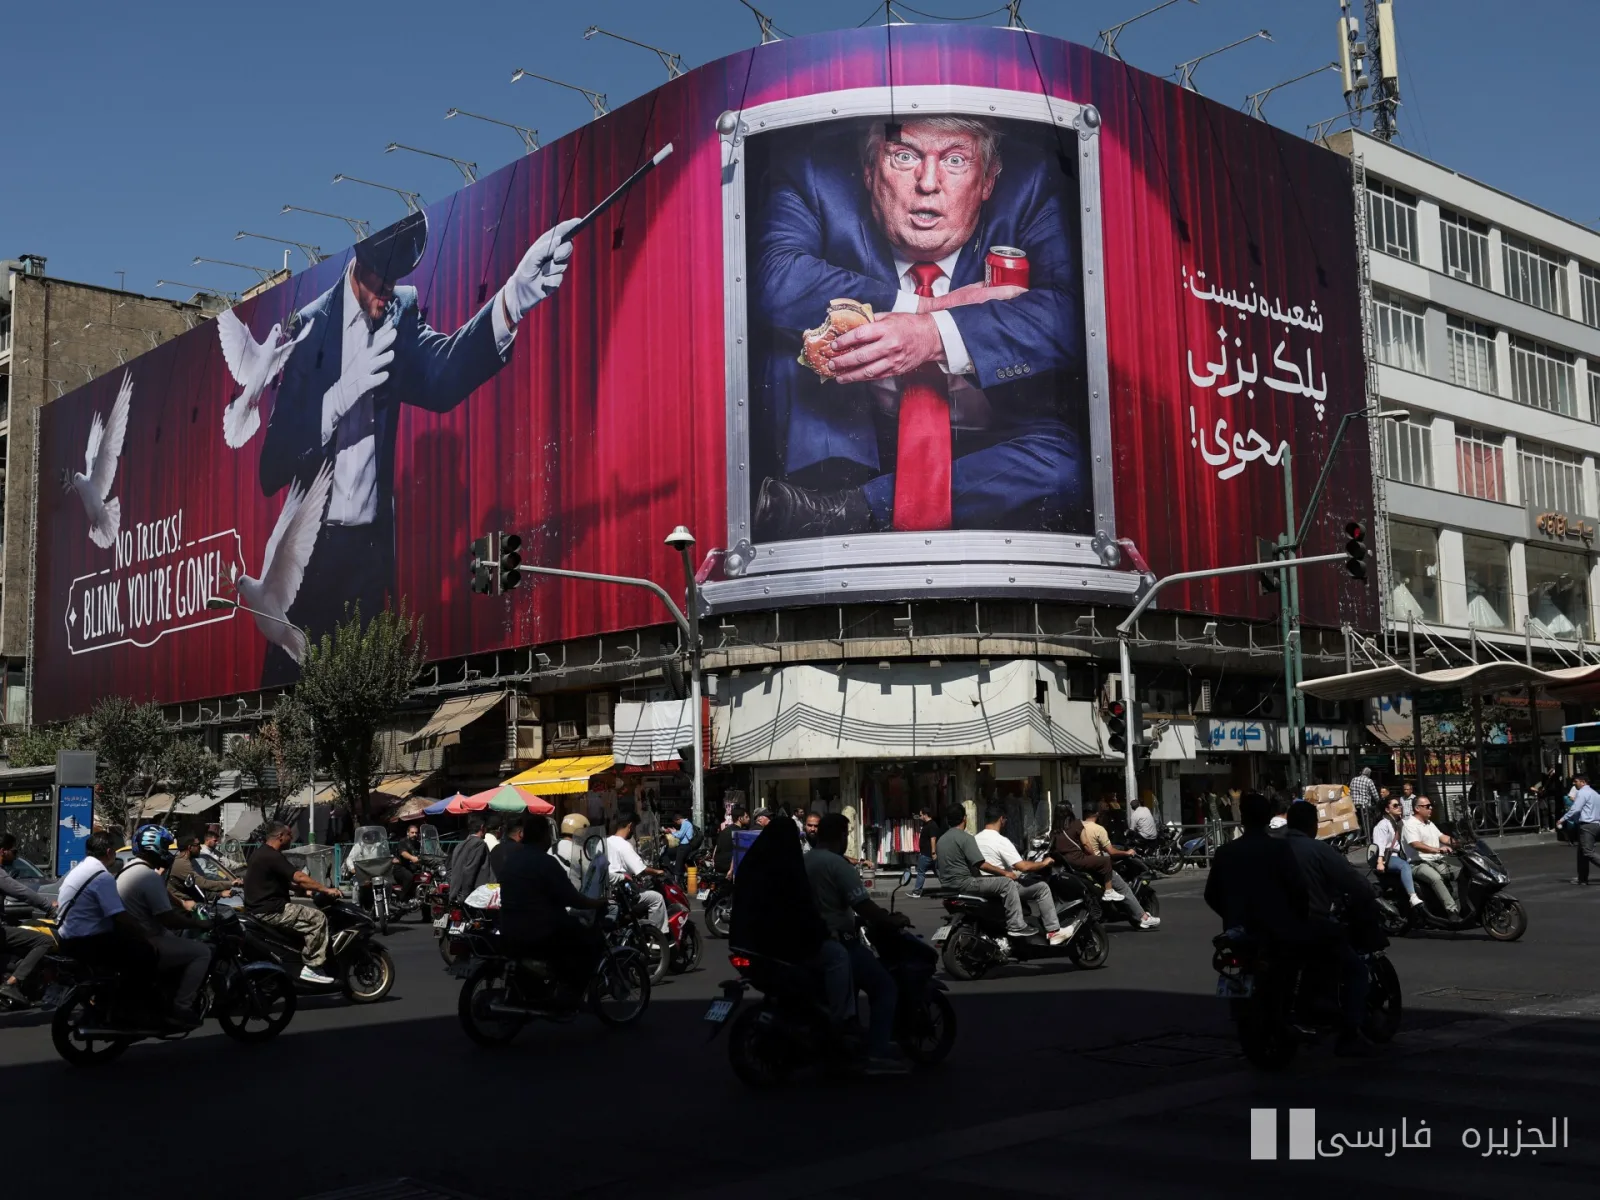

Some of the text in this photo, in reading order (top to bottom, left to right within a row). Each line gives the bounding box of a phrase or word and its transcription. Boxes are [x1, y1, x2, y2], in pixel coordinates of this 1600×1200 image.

[1182, 265, 1323, 333] شعبده نیست!
[1187, 326, 1328, 421] پلک بزنی
[116, 509, 182, 570] NO TRICKS!
[83, 550, 221, 640] BLINK, YOU'RE GONE!
